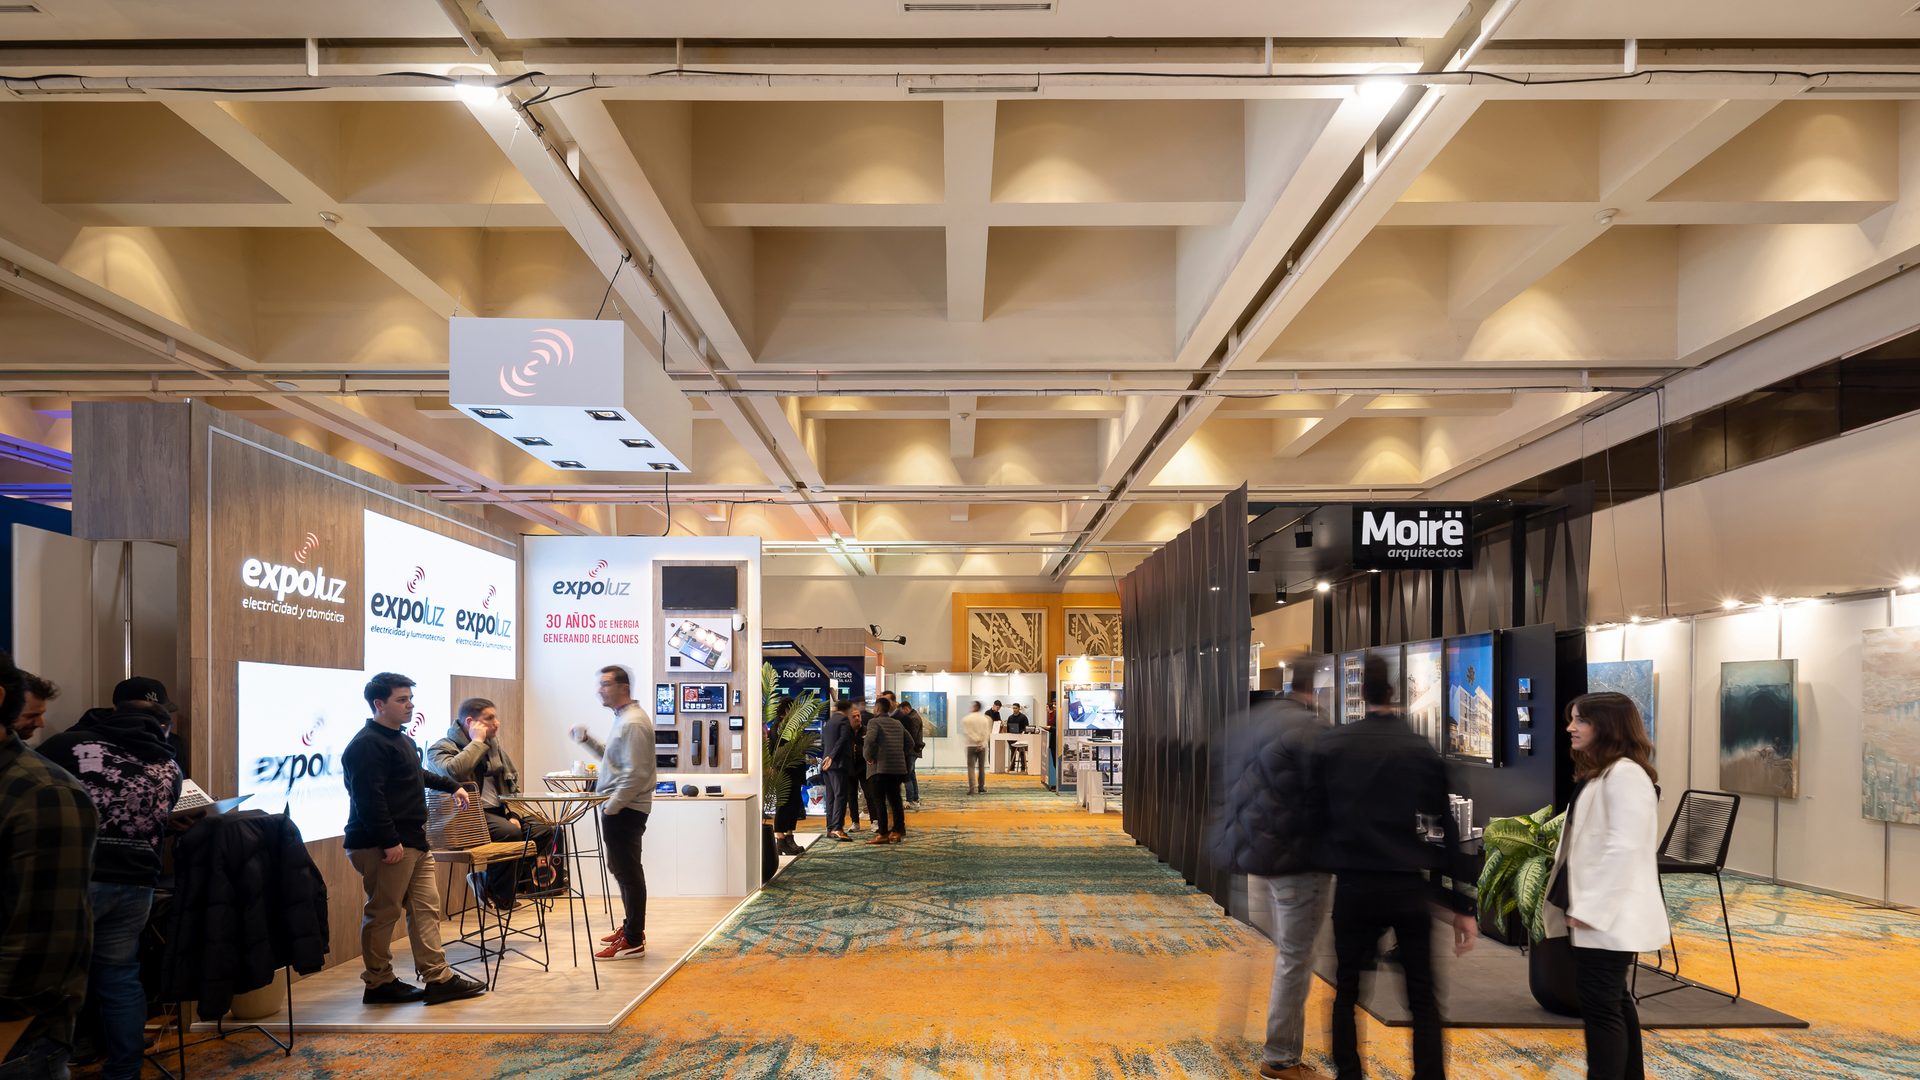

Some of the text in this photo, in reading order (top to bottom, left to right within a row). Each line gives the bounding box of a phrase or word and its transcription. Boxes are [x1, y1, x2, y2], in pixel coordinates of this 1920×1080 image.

[1361, 510, 1463, 546] Moirë
[1387, 547, 1463, 561] arquitectos
[242, 558, 347, 604] expoluz
[552, 577, 631, 600] expoluz
[242, 597, 345, 623] electricidad y domótica
[370, 592, 446, 628] expoluz
[546, 611, 640, 629] 30 AÑOS DE ENERGIA
[370, 624, 406, 637] electricidad
[405, 631, 410, 639] y
[455, 609, 512, 640] expoluz
[543, 633, 639, 644] GENERANDO RELACIONES
[783, 669, 816, 679] Rodolfo
